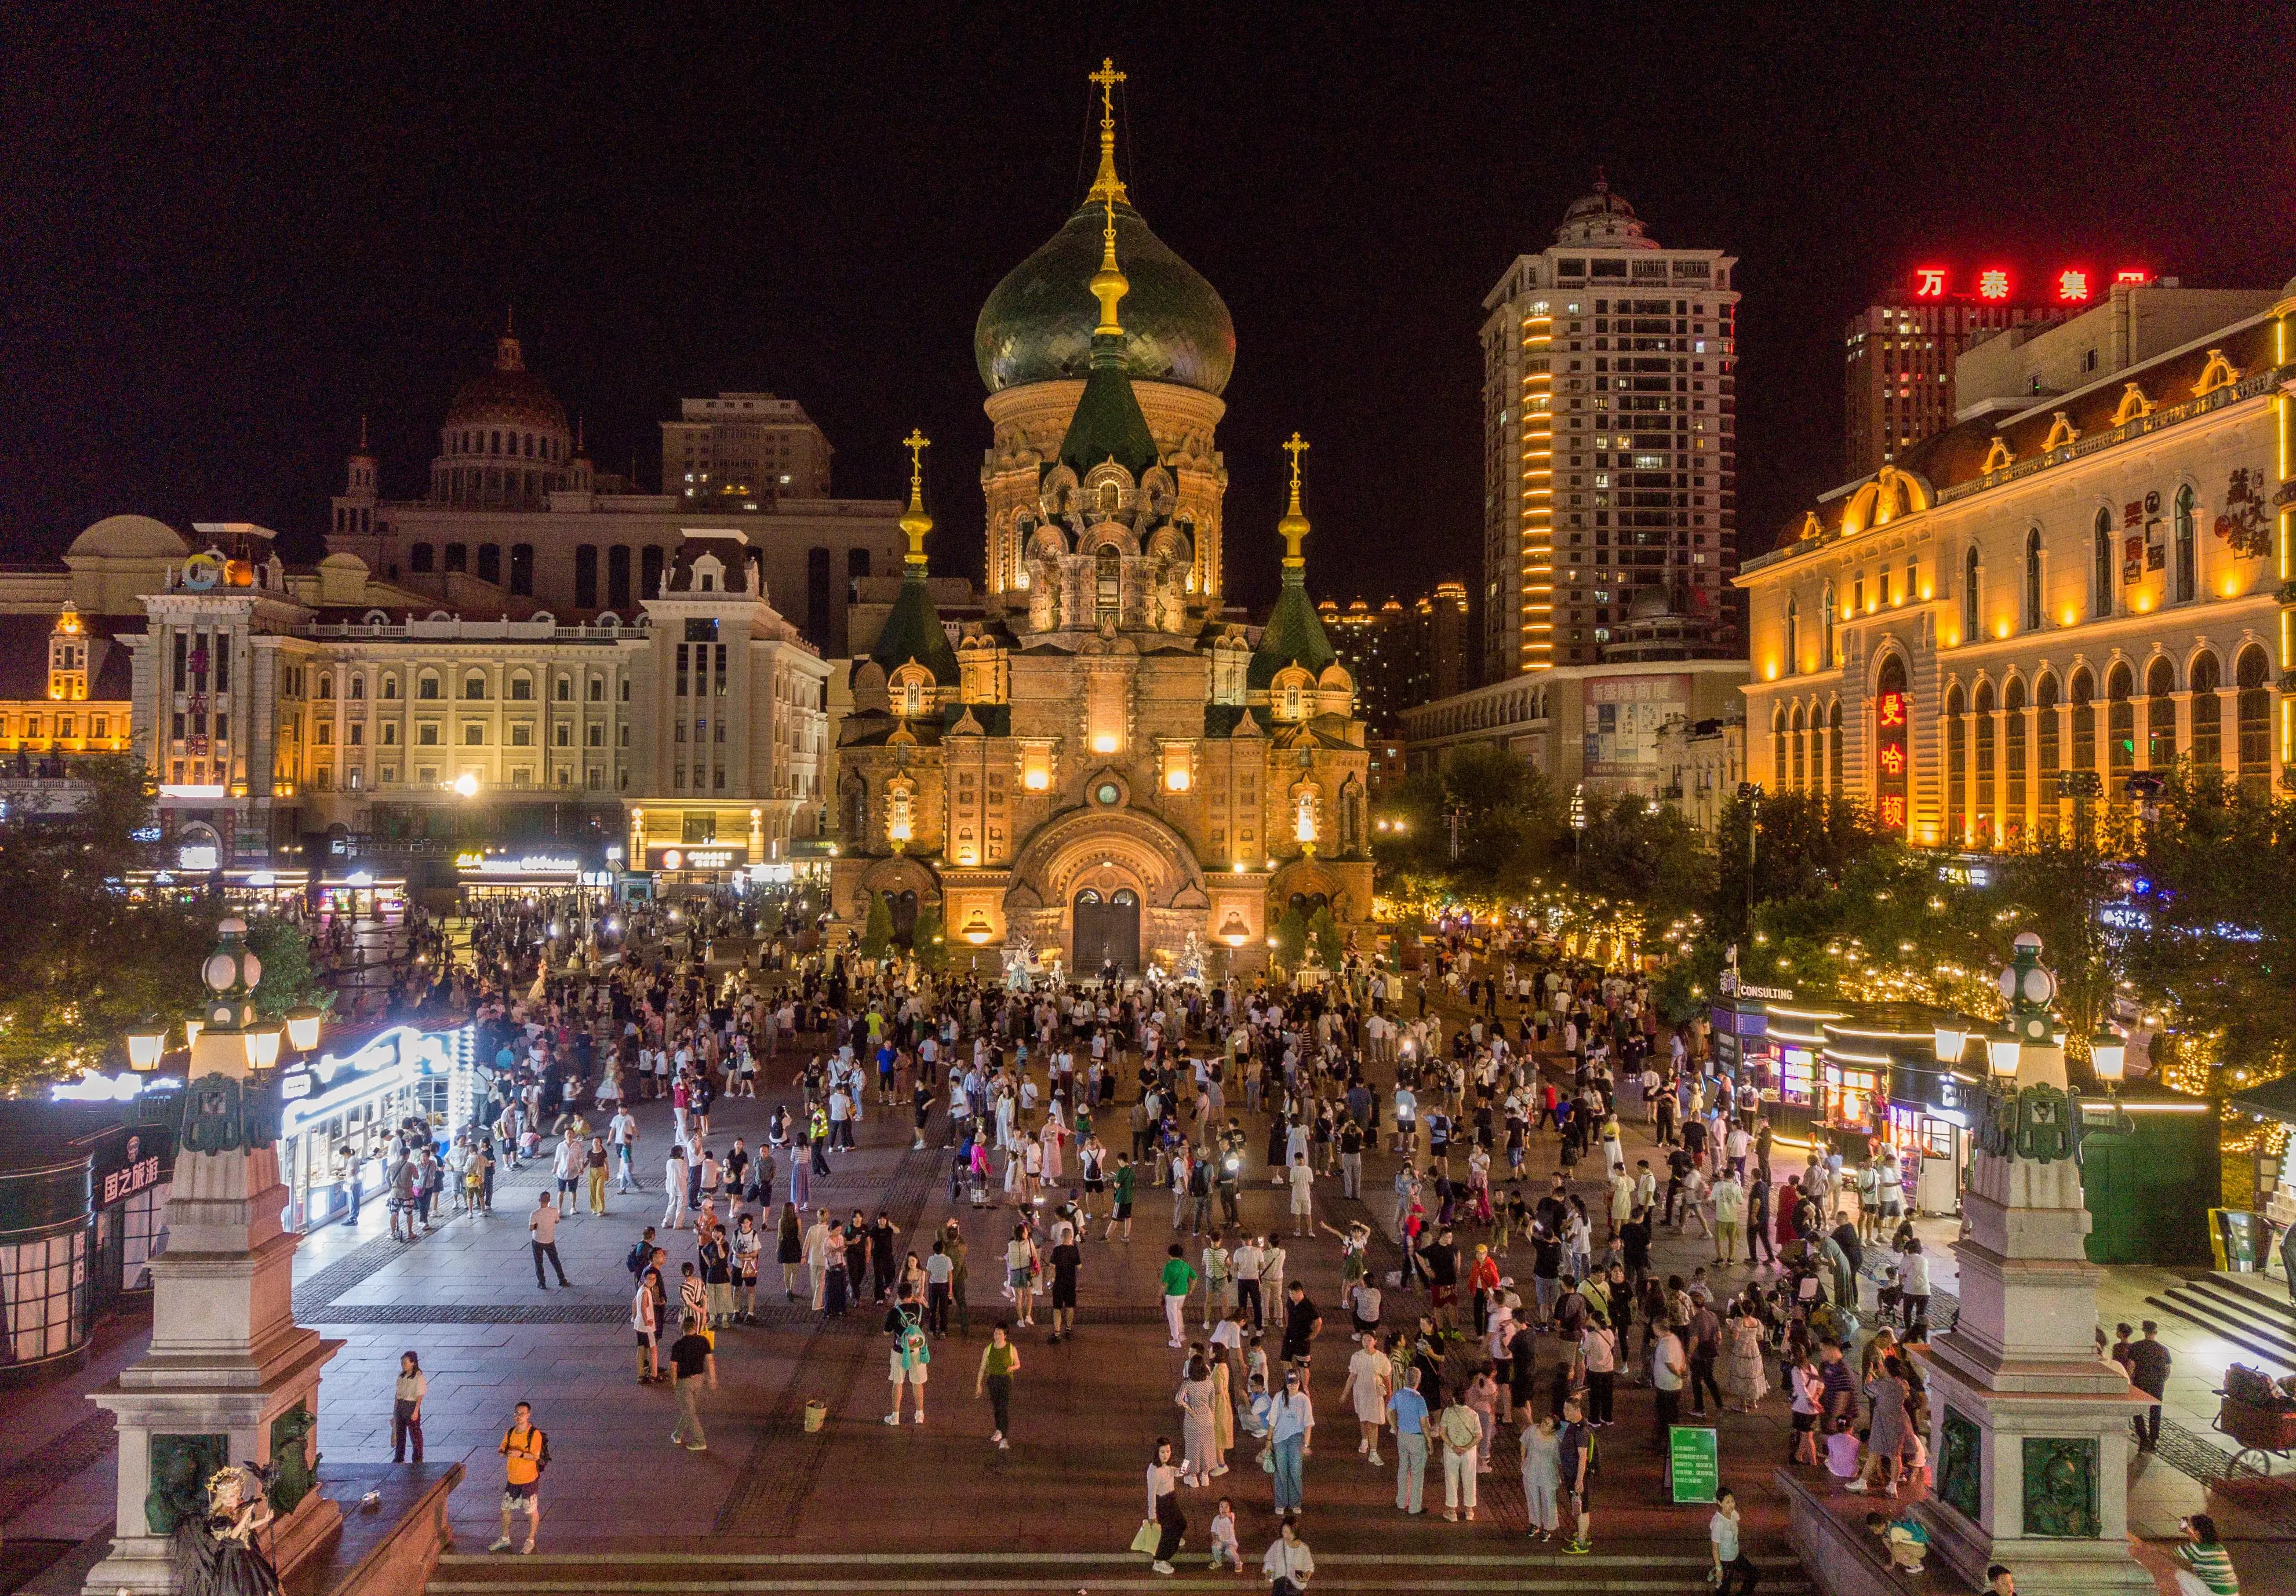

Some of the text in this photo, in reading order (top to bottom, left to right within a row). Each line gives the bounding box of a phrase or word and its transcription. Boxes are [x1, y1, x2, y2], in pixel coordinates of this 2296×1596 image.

[1880, 694, 1905, 826] 曼哈顿
[1741, 985, 1793, 1000] CONSULTING
[104, 1156, 158, 1203] 国之旅游
